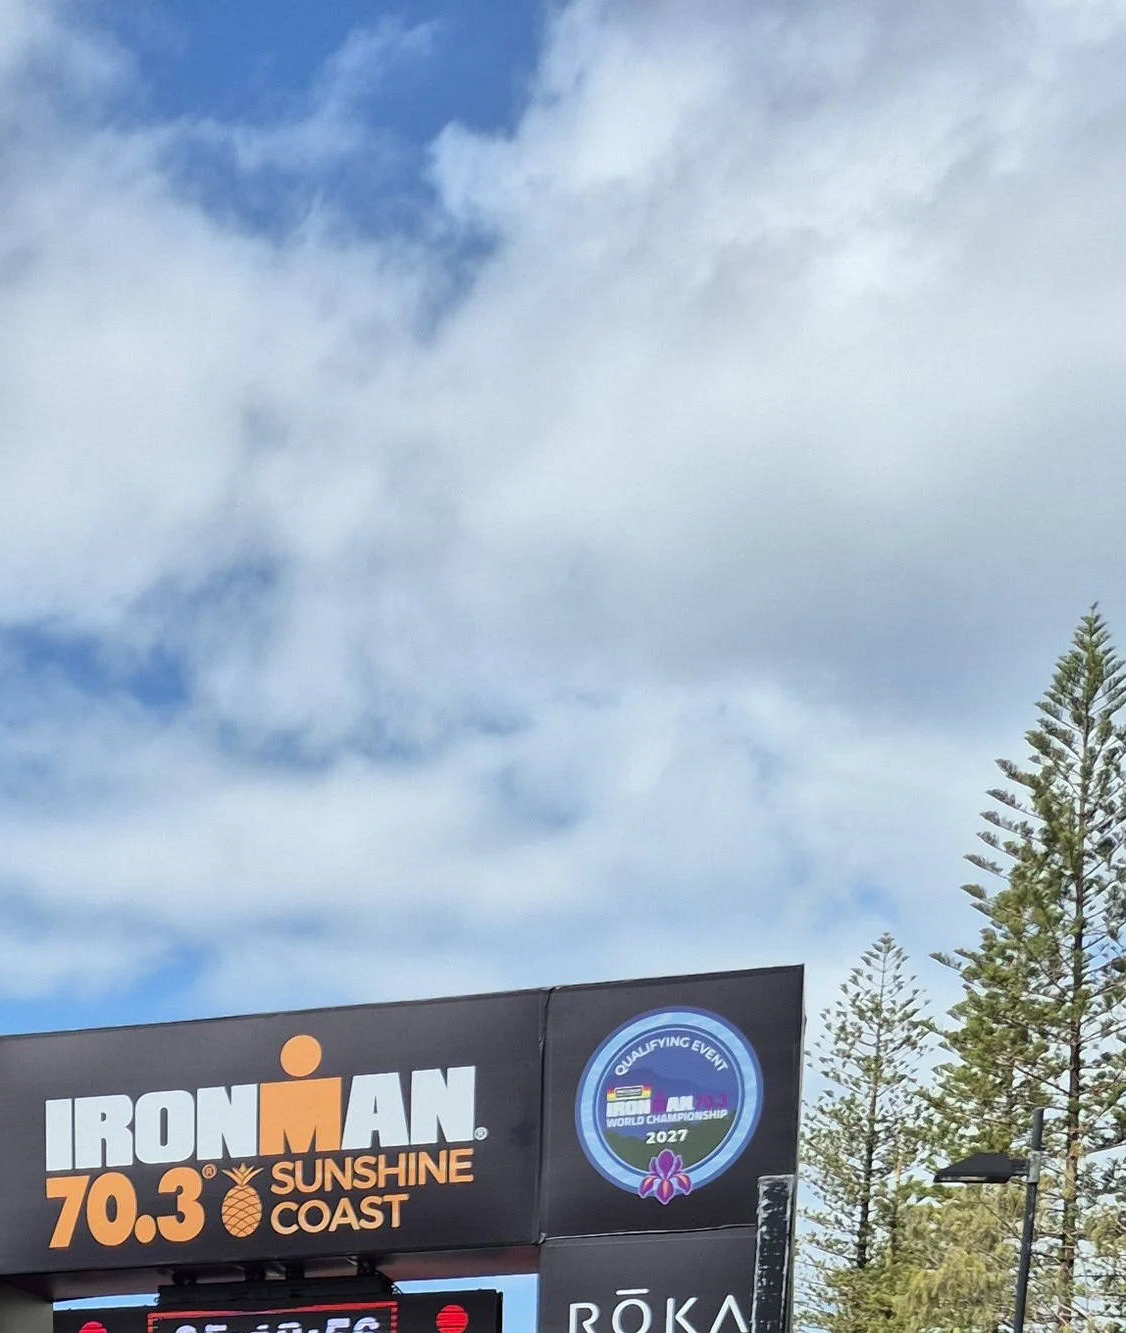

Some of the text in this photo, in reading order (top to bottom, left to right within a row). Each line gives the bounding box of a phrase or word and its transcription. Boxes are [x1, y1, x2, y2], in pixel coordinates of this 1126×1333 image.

[614, 1036, 729, 1077] QUALIFYING EVENT
[45, 1064, 476, 1172] IRONMAN
[606, 1109, 728, 1128] WORLD CHAMPIONSHIP
[645, 1129, 688, 1145] 2027
[270, 1147, 474, 1195] SUNSHINE
[45, 1166, 205, 1249] 70.3
[270, 1193, 410, 1236] COAST
